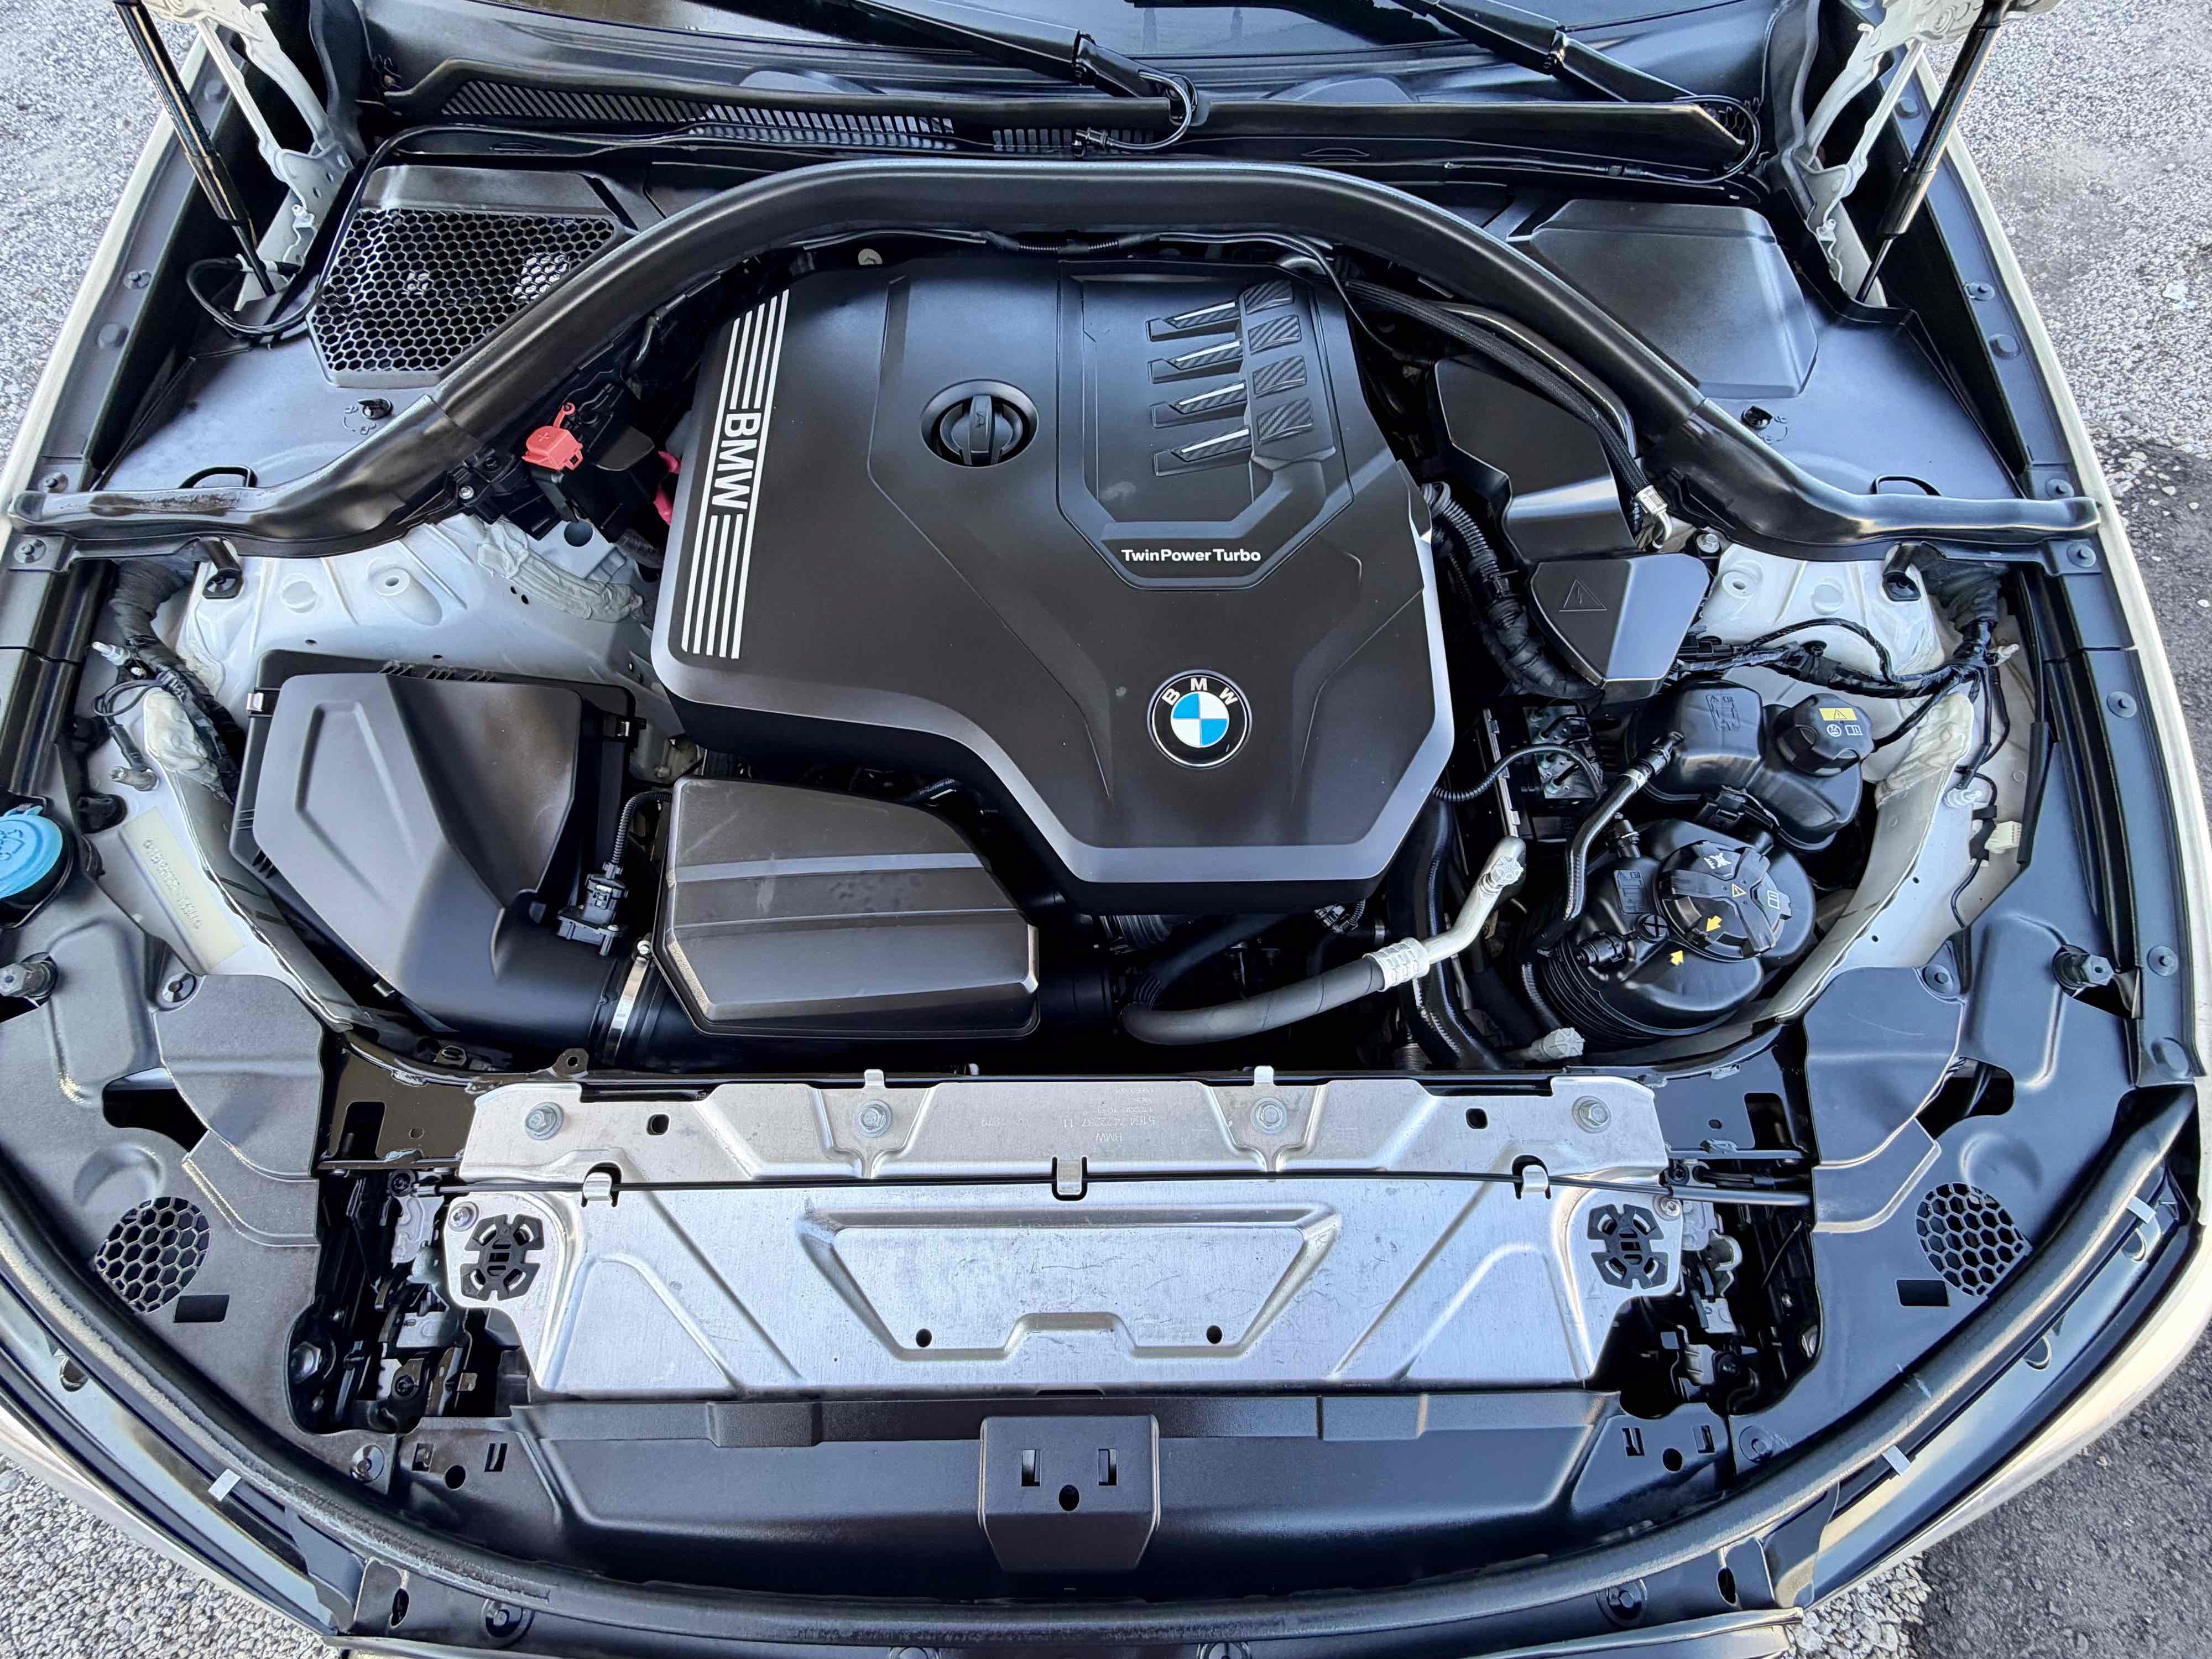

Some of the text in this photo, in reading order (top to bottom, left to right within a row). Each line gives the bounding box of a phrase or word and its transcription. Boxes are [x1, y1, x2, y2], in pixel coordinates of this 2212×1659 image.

[712, 413, 762, 509] BMW
[1121, 549, 1261, 561] TwinPower Turbo
[1161, 677, 1239, 706] BMW
[1095, 1133, 1123, 1142] BMW
